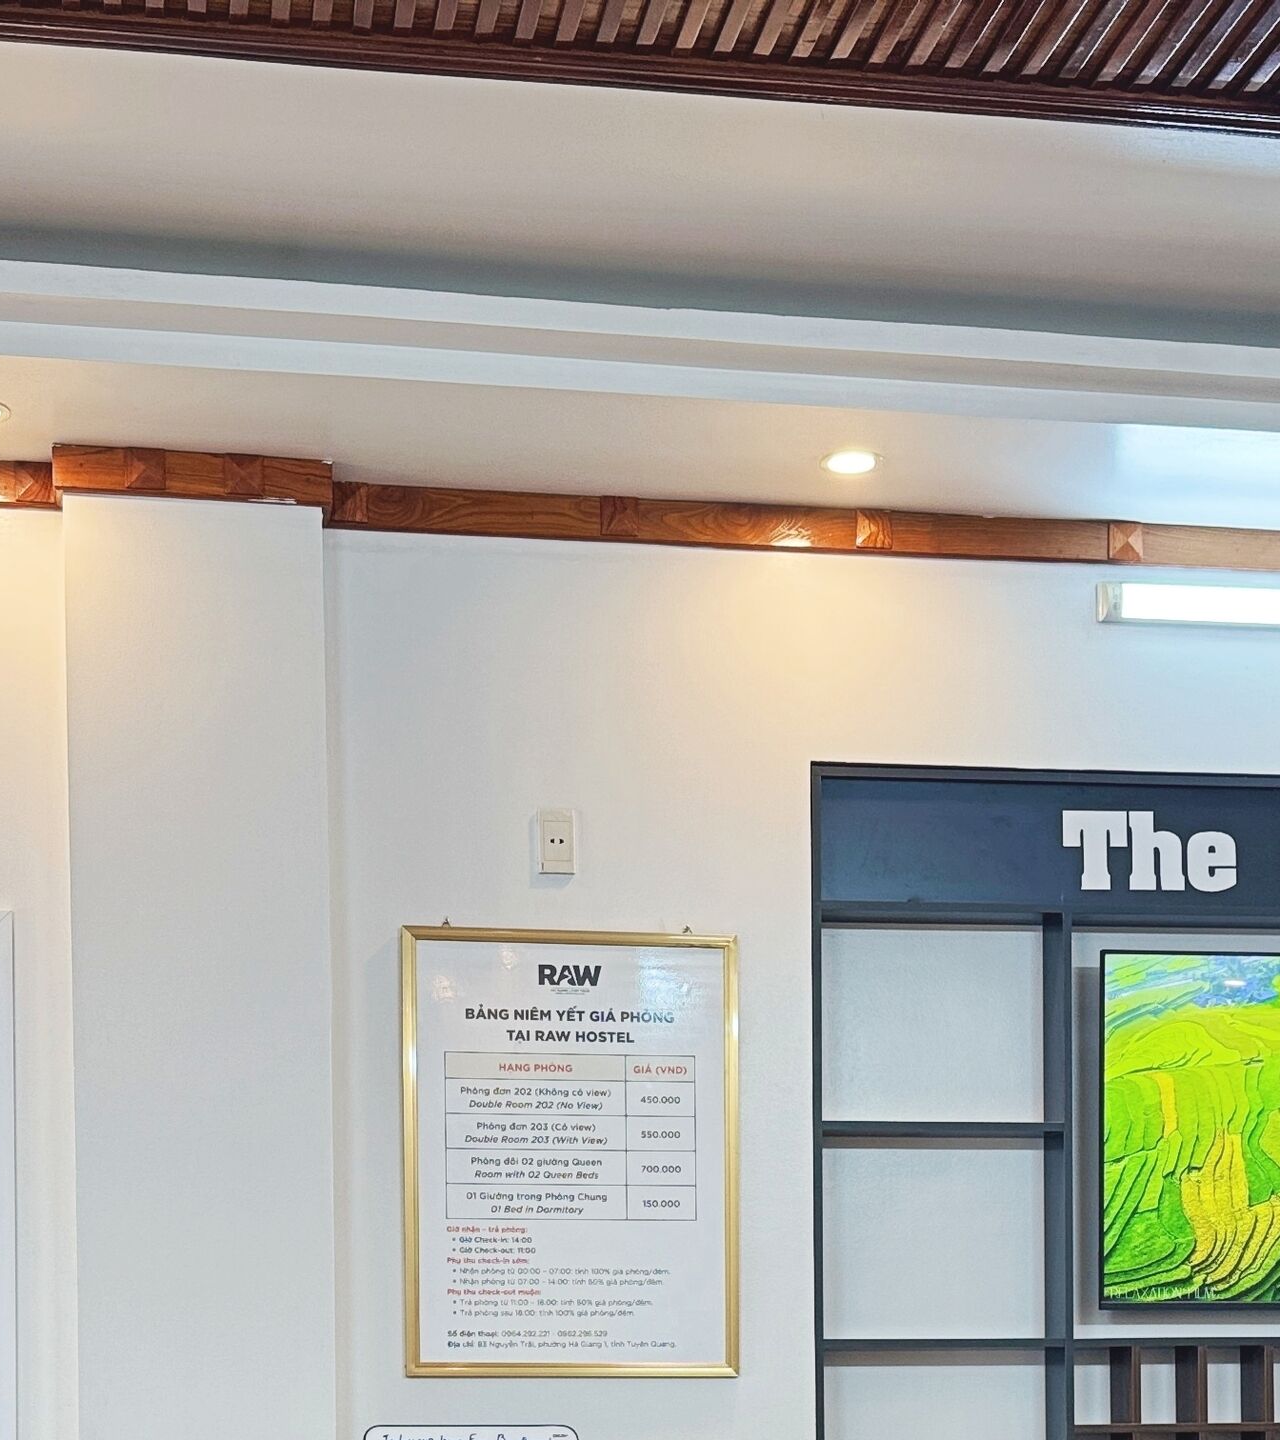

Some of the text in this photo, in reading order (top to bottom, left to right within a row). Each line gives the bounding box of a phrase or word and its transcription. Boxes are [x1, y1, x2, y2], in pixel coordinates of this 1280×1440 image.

[1061, 810, 1238, 893] The
[538, 964, 602, 987] RAW
[535, 1030, 571, 1042] RAW
[575, 1031, 635, 1043] HOSTEL
[655, 1066, 687, 1075] (VND)
[468, 1100, 503, 1108] Double
[505, 1100, 533, 1108] Room
[534, 1100, 554, 1109] 202
[640, 1096, 680, 1104] 450.000
[641, 1130, 680, 1139] 550.000
[464, 1135, 498, 1143] Double
[500, 1135, 529, 1143] Room
[530, 1135, 550, 1144] 203
[641, 1165, 681, 1173] 700.000
[474, 1170, 502, 1178] Room
[505, 1170, 525, 1178] with
[528, 1170, 541, 1179] 02
[543, 1170, 573, 1179] Queen
[642, 1199, 680, 1208] 150.000
[490, 1205, 584, 1215] 01 Bed in Dormitory
